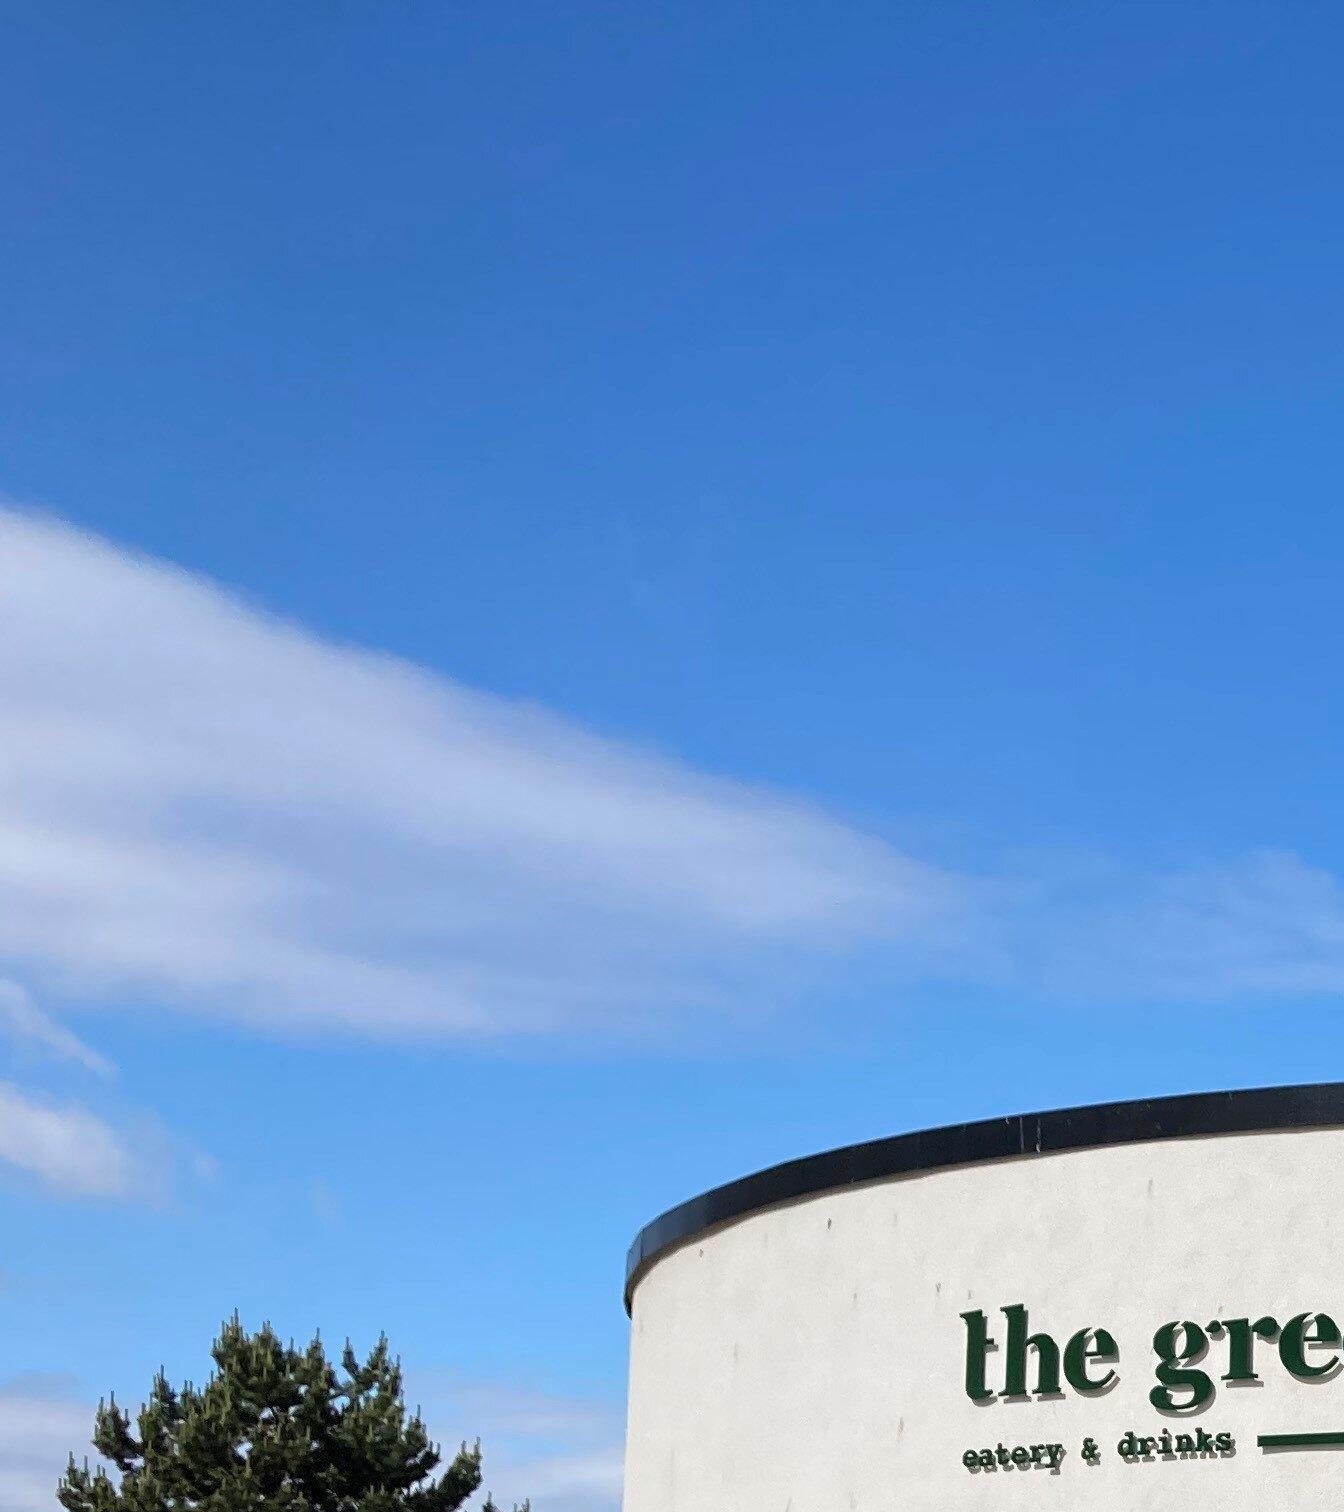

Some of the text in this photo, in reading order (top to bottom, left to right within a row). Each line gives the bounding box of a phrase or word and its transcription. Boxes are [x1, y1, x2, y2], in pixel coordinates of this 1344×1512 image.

[959, 1303, 1121, 1402] the
[962, 1427, 1233, 1471] eatery & drinks
